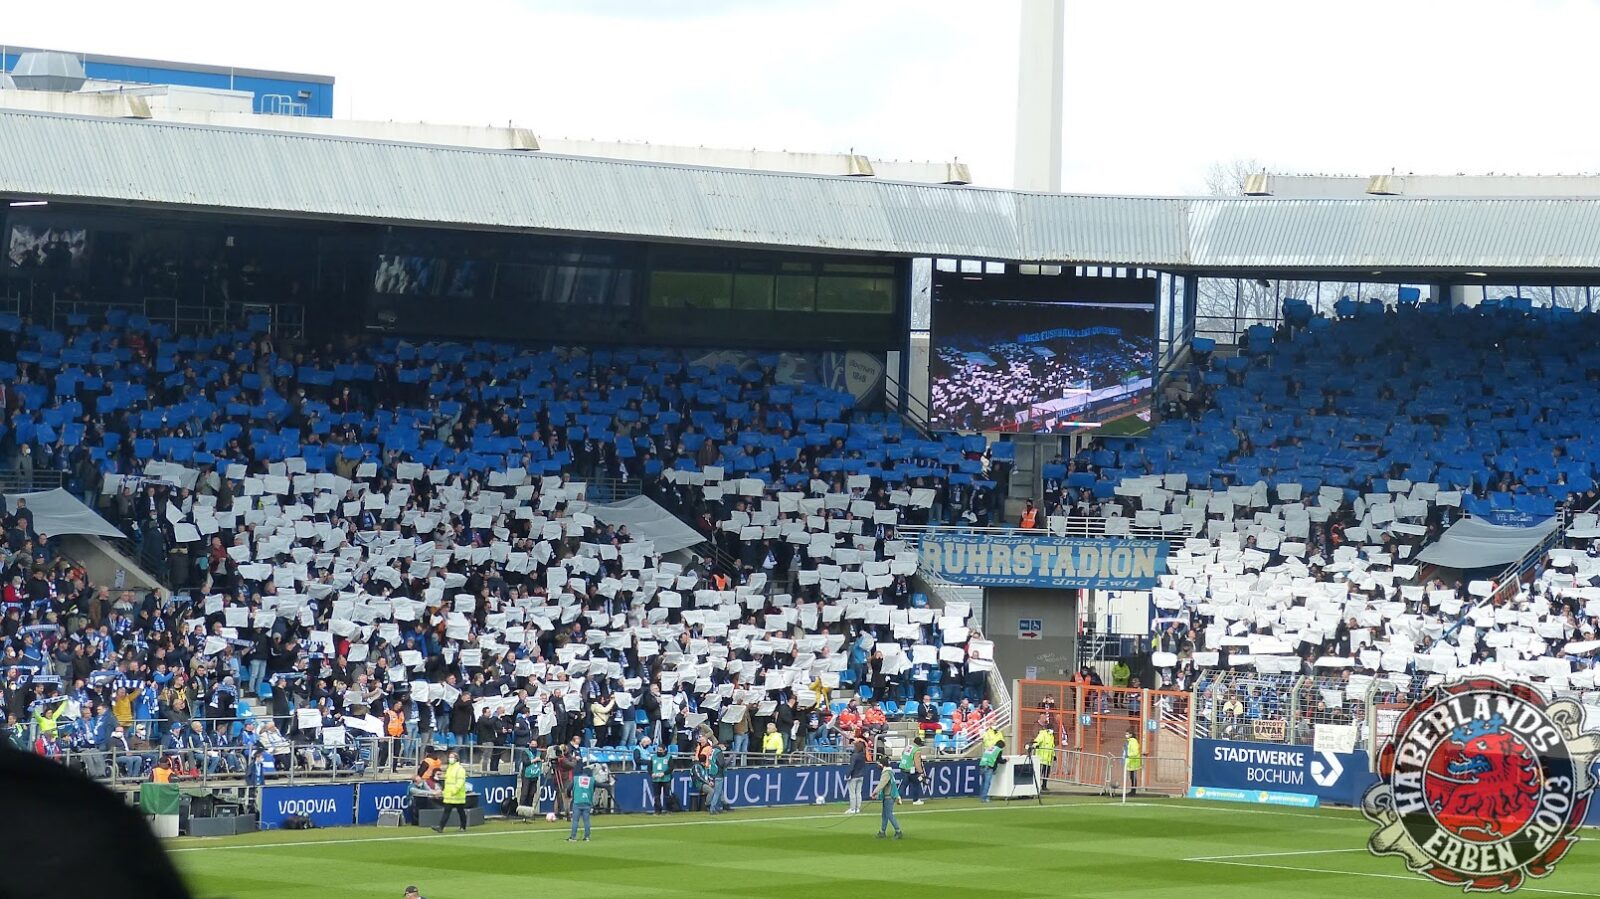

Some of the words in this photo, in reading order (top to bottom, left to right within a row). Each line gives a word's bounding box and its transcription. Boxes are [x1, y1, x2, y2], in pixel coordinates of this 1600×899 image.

[922, 541, 1158, 578] RUHRSTADION
[1082, 715, 1091, 725] 19
[1255, 726, 1282, 735] QATAR
[1214, 746, 1304, 767] STADTWERKE
[1247, 767, 1304, 785] BOCHUM
[724, 772, 782, 804] UCH
[795, 771, 850, 801] ZUM
[278, 798, 337, 815] VONOVIA
